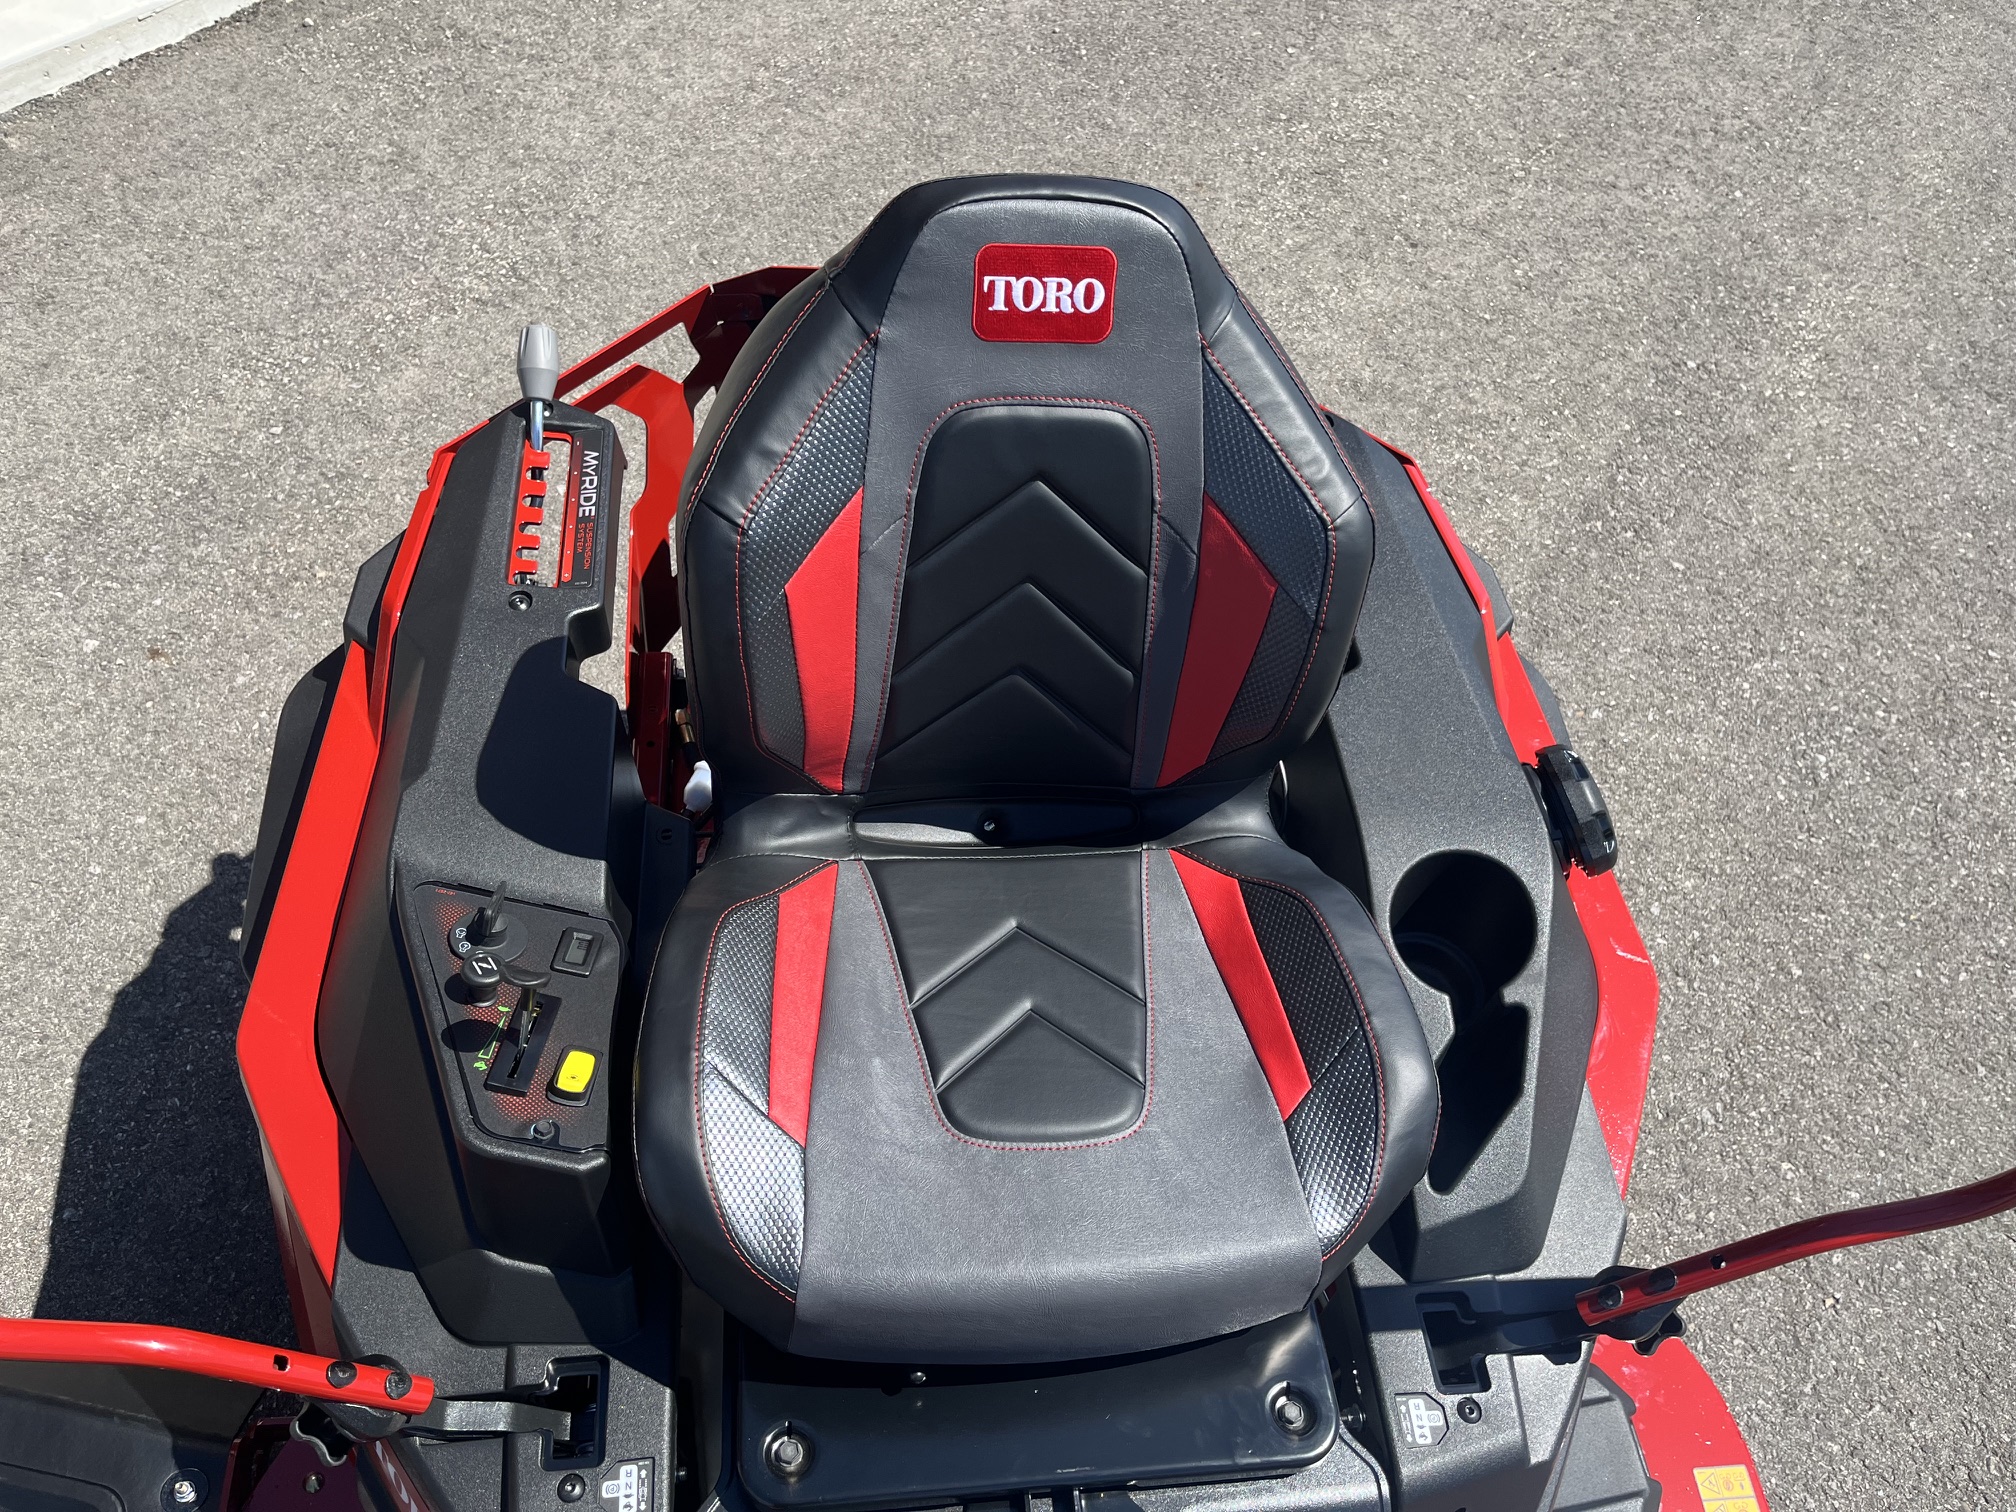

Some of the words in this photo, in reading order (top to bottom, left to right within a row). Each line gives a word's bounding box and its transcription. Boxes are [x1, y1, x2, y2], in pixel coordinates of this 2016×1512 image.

[983, 275, 1106, 314] TORO
[576, 523, 585, 554] SYSTEM
[583, 522, 594, 570] SUSPENSION
[1416, 1414, 1423, 1422] N
[625, 1469, 632, 1478] R
[625, 1482, 632, 1491] N
